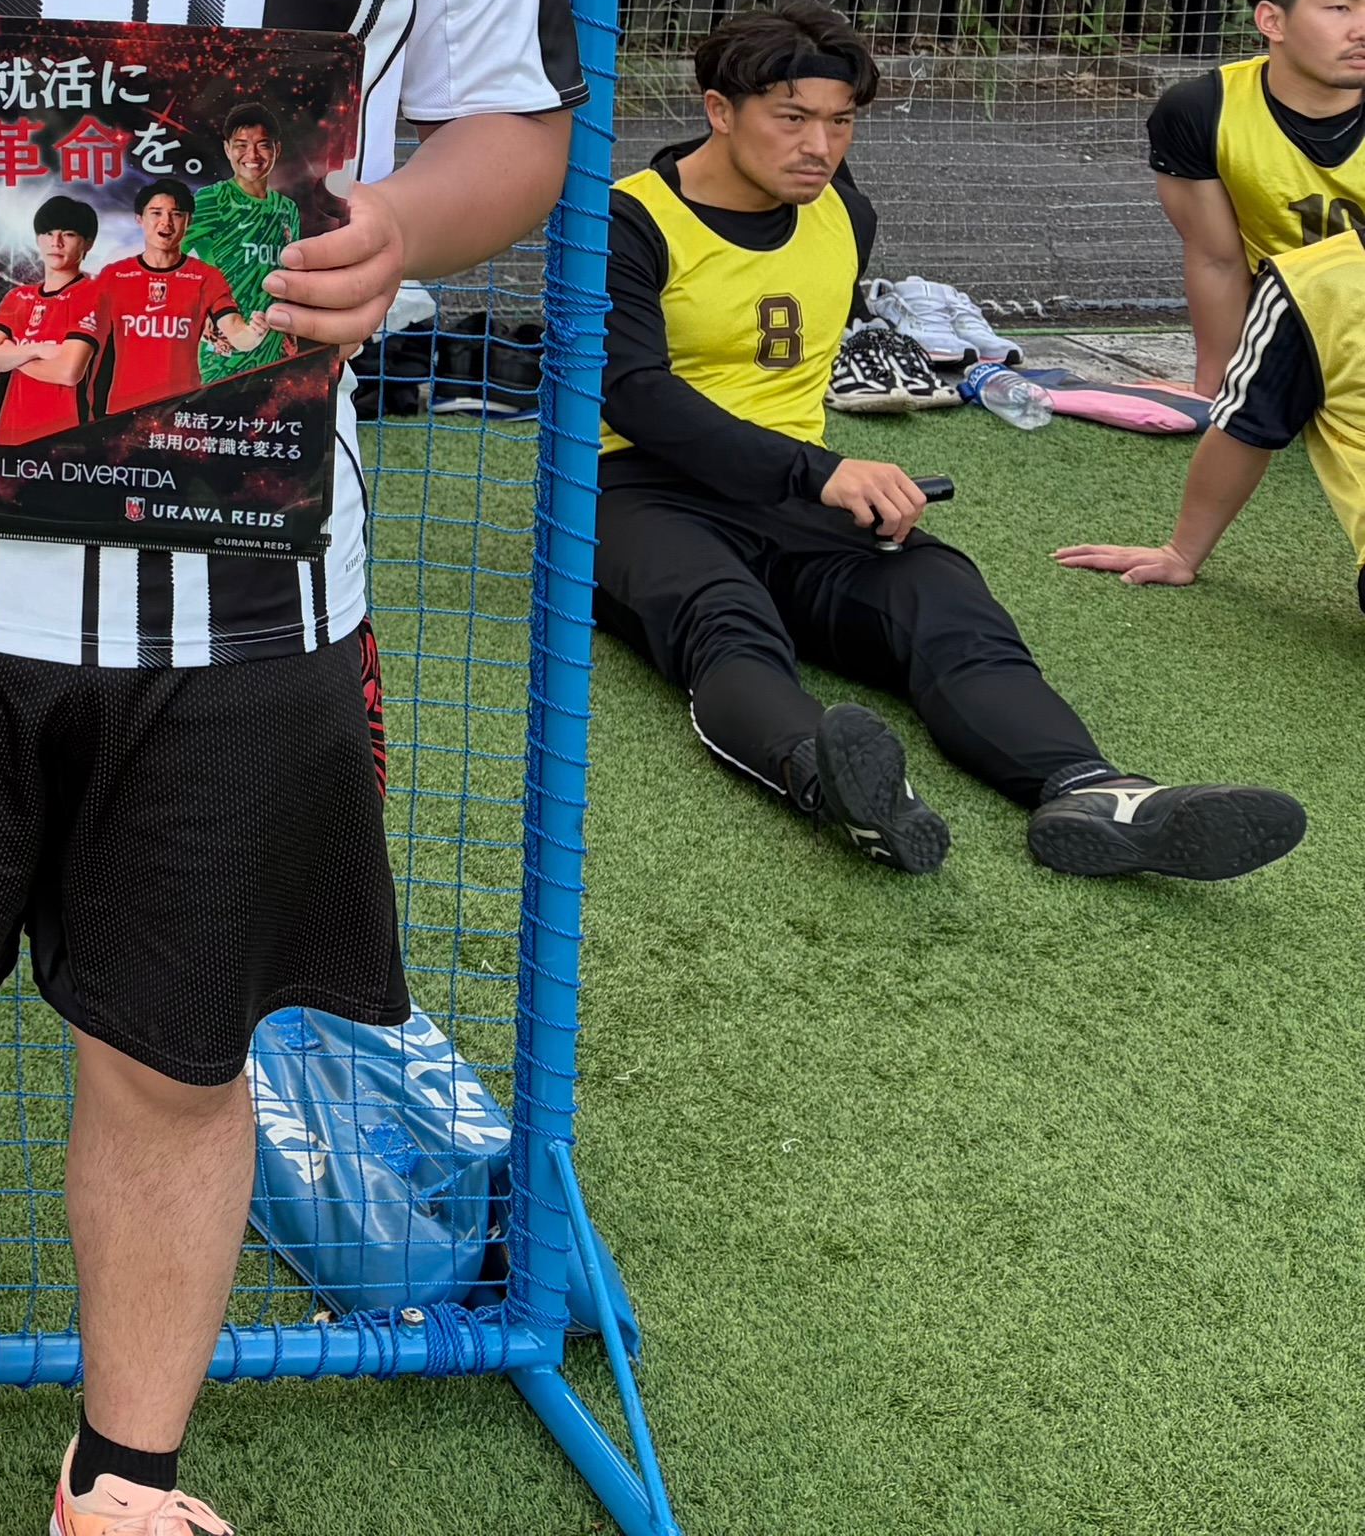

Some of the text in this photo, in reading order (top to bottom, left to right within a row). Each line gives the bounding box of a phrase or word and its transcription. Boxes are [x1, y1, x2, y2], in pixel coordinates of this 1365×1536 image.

[121, 315, 192, 339] POLUS
[754, 293, 804, 371] 8
[174, 412, 302, 436] 就活フットサルで
[148, 434, 303, 459] 採用の常識を変える
[152, 504, 286, 528] URAWA REDS
[264, 541, 292, 551] REDS
